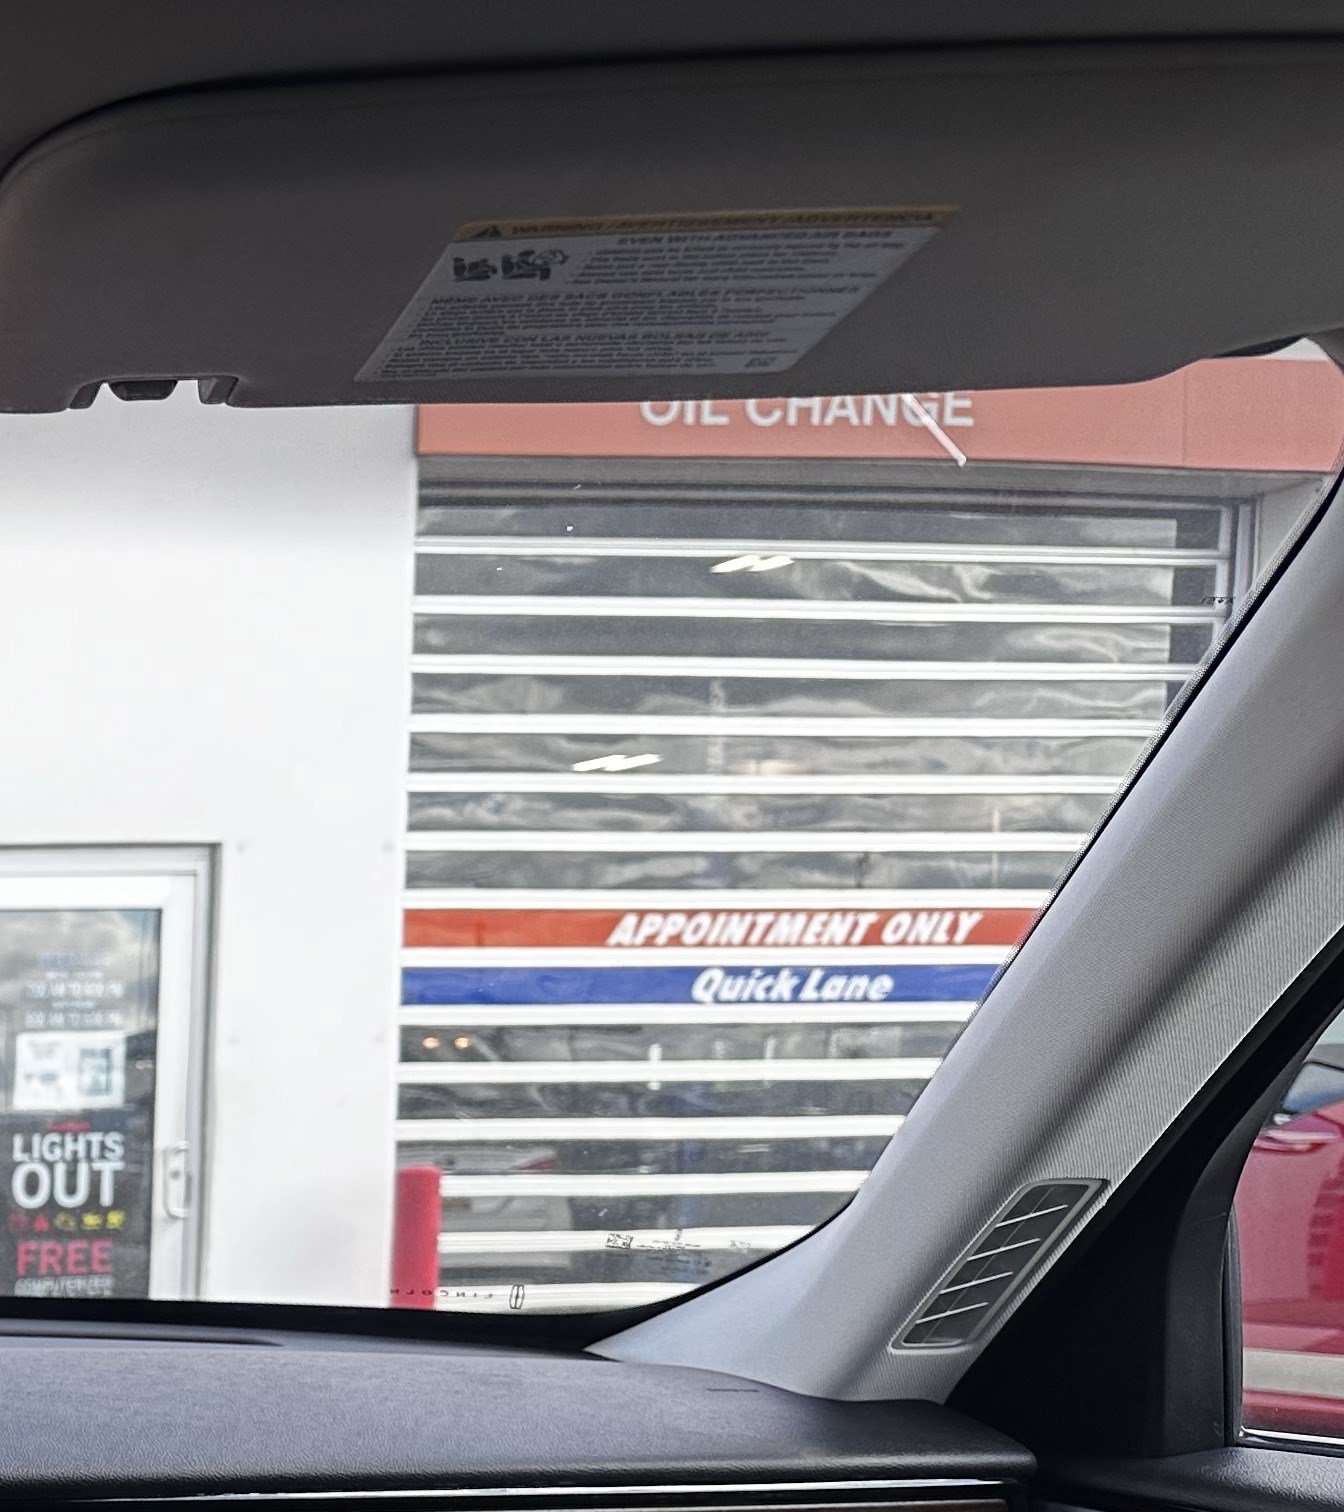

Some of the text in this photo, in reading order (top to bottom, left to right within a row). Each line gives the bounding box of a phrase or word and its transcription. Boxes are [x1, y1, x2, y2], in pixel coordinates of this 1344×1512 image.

[639, 391, 975, 427] OIL CHANGE
[605, 910, 984, 947] APPOINTMENT ONLY
[691, 967, 895, 1005] Quick Lane
[12, 1131, 126, 1162] LIGHTS
[11, 1161, 126, 1209] OUT
[16, 1238, 113, 1276] FREE
